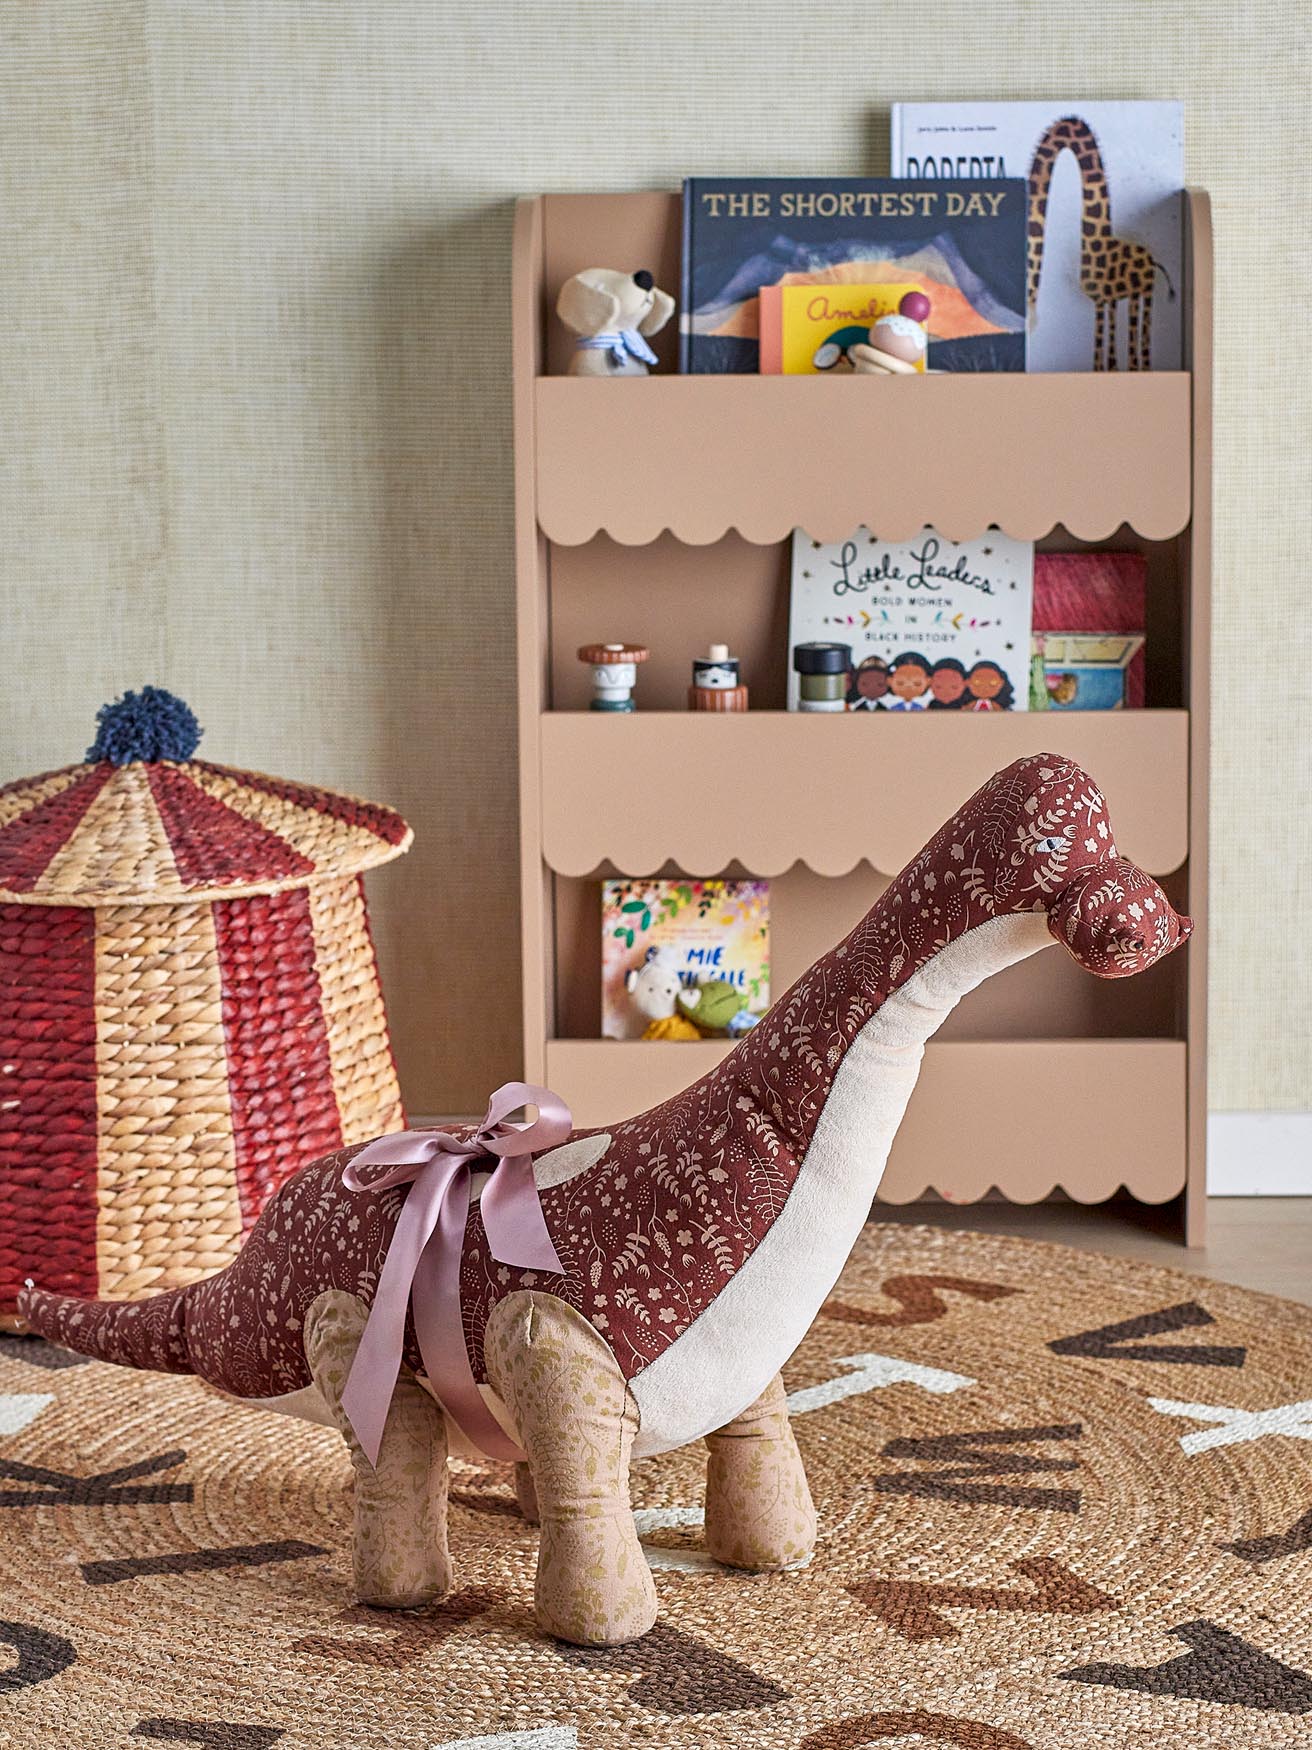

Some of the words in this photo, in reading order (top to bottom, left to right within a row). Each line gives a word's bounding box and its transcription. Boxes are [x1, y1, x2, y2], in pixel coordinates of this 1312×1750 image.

[702, 193, 770, 217] THE
[780, 193, 938, 217] SHORTEST
[945, 192, 1006, 216] DAY
[830, 541, 905, 596] Little
[906, 538, 995, 596] Leaders
[872, 597, 903, 606] BOLD
[908, 597, 953, 607] WOMEN
[904, 616, 918, 625] IN
[865, 632, 898, 642] BLACK
[903, 633, 956, 643] HISTORY
